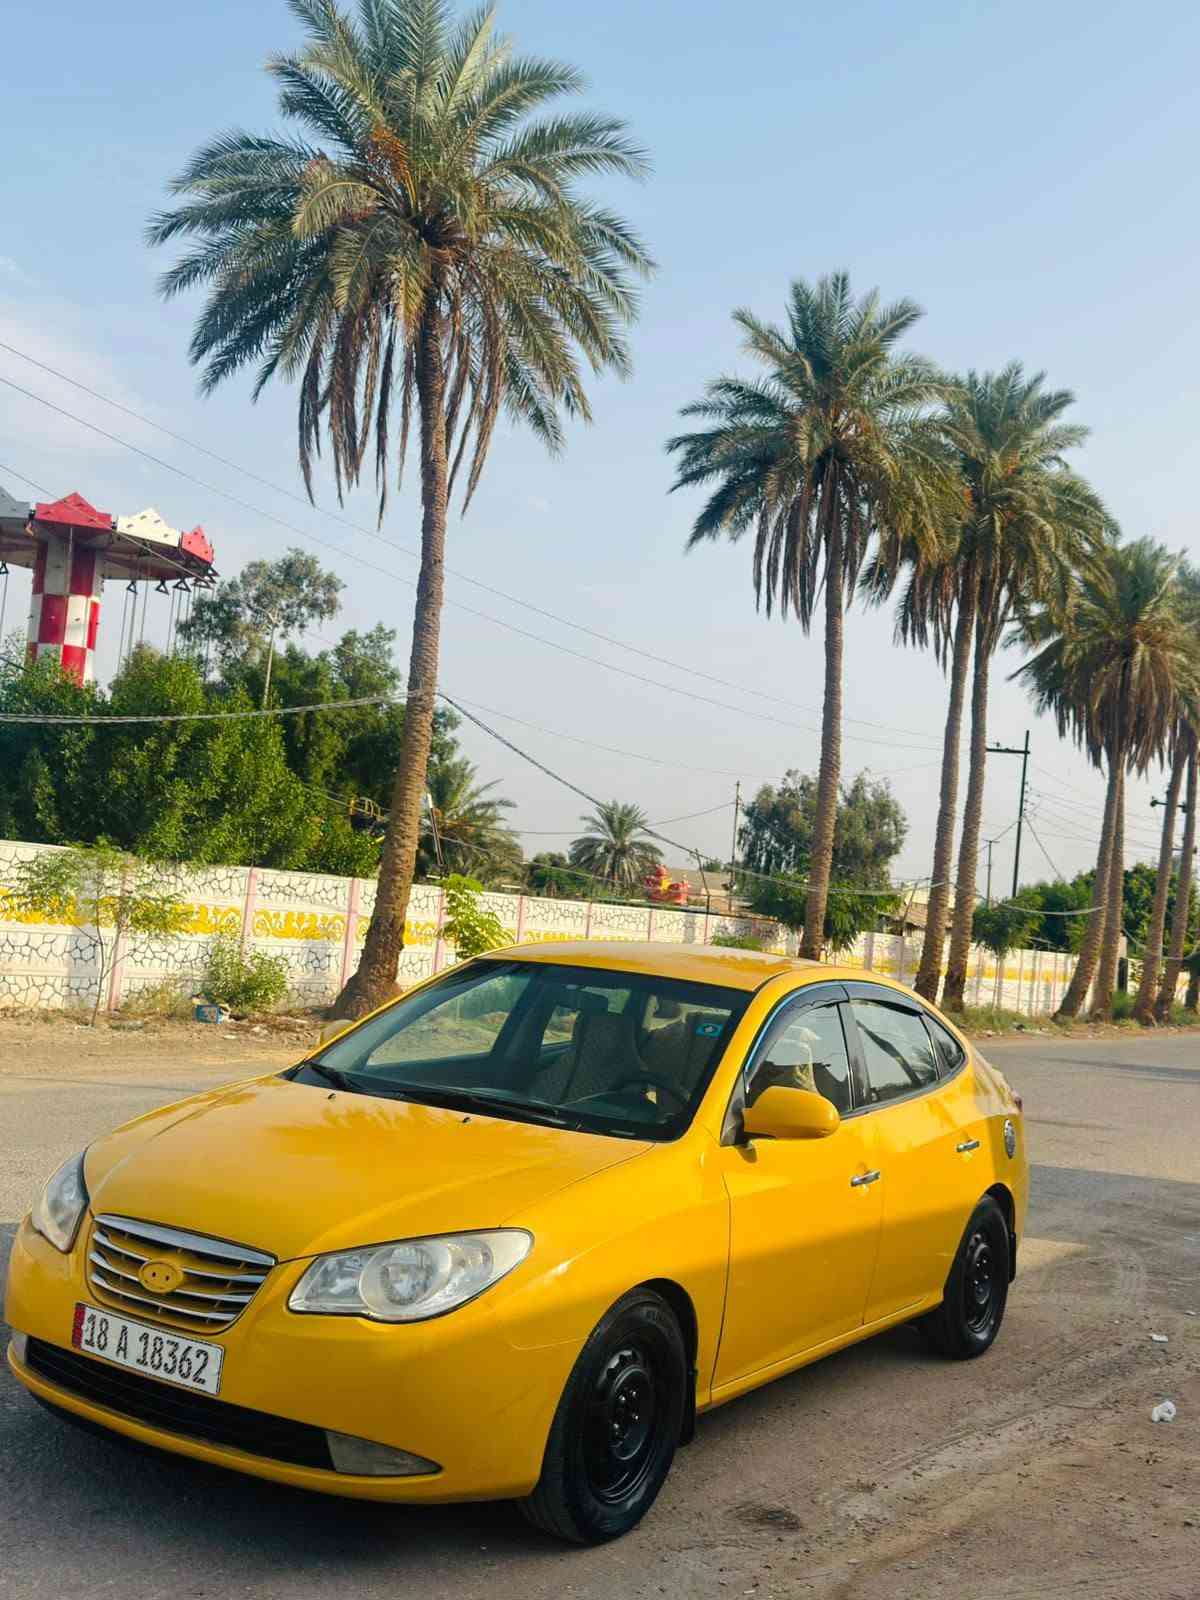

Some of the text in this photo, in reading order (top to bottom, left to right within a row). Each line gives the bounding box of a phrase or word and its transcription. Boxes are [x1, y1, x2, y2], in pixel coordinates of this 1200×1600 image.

[84, 1313, 109, 1351] 18
[115, 1325, 128, 1360] A
[136, 1332, 209, 1385] 18362
